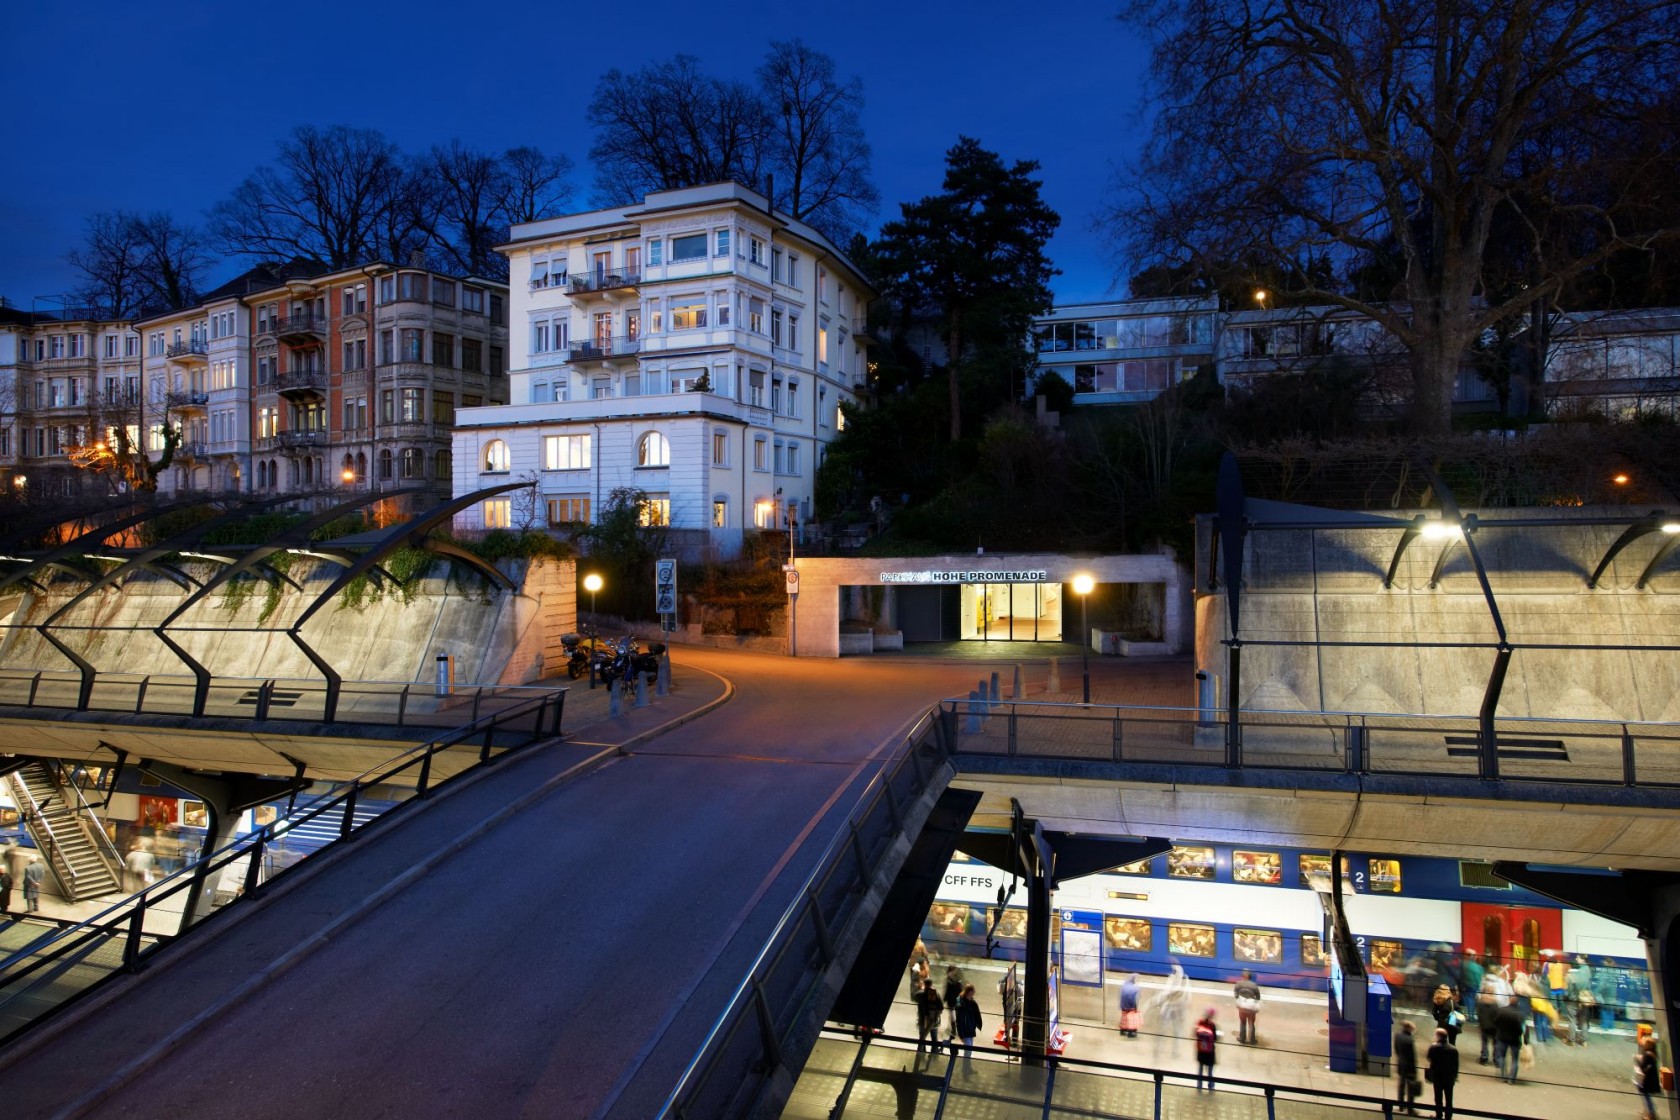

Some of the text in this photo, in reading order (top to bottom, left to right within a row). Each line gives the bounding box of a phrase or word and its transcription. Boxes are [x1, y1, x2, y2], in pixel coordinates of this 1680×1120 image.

[933, 572, 966, 581] HOHE
[969, 571, 1046, 580] PROMENADE
[944, 875, 993, 888] CFF FFS
[1355, 871, 1364, 883] 2
[1356, 936, 1365, 948] 2
